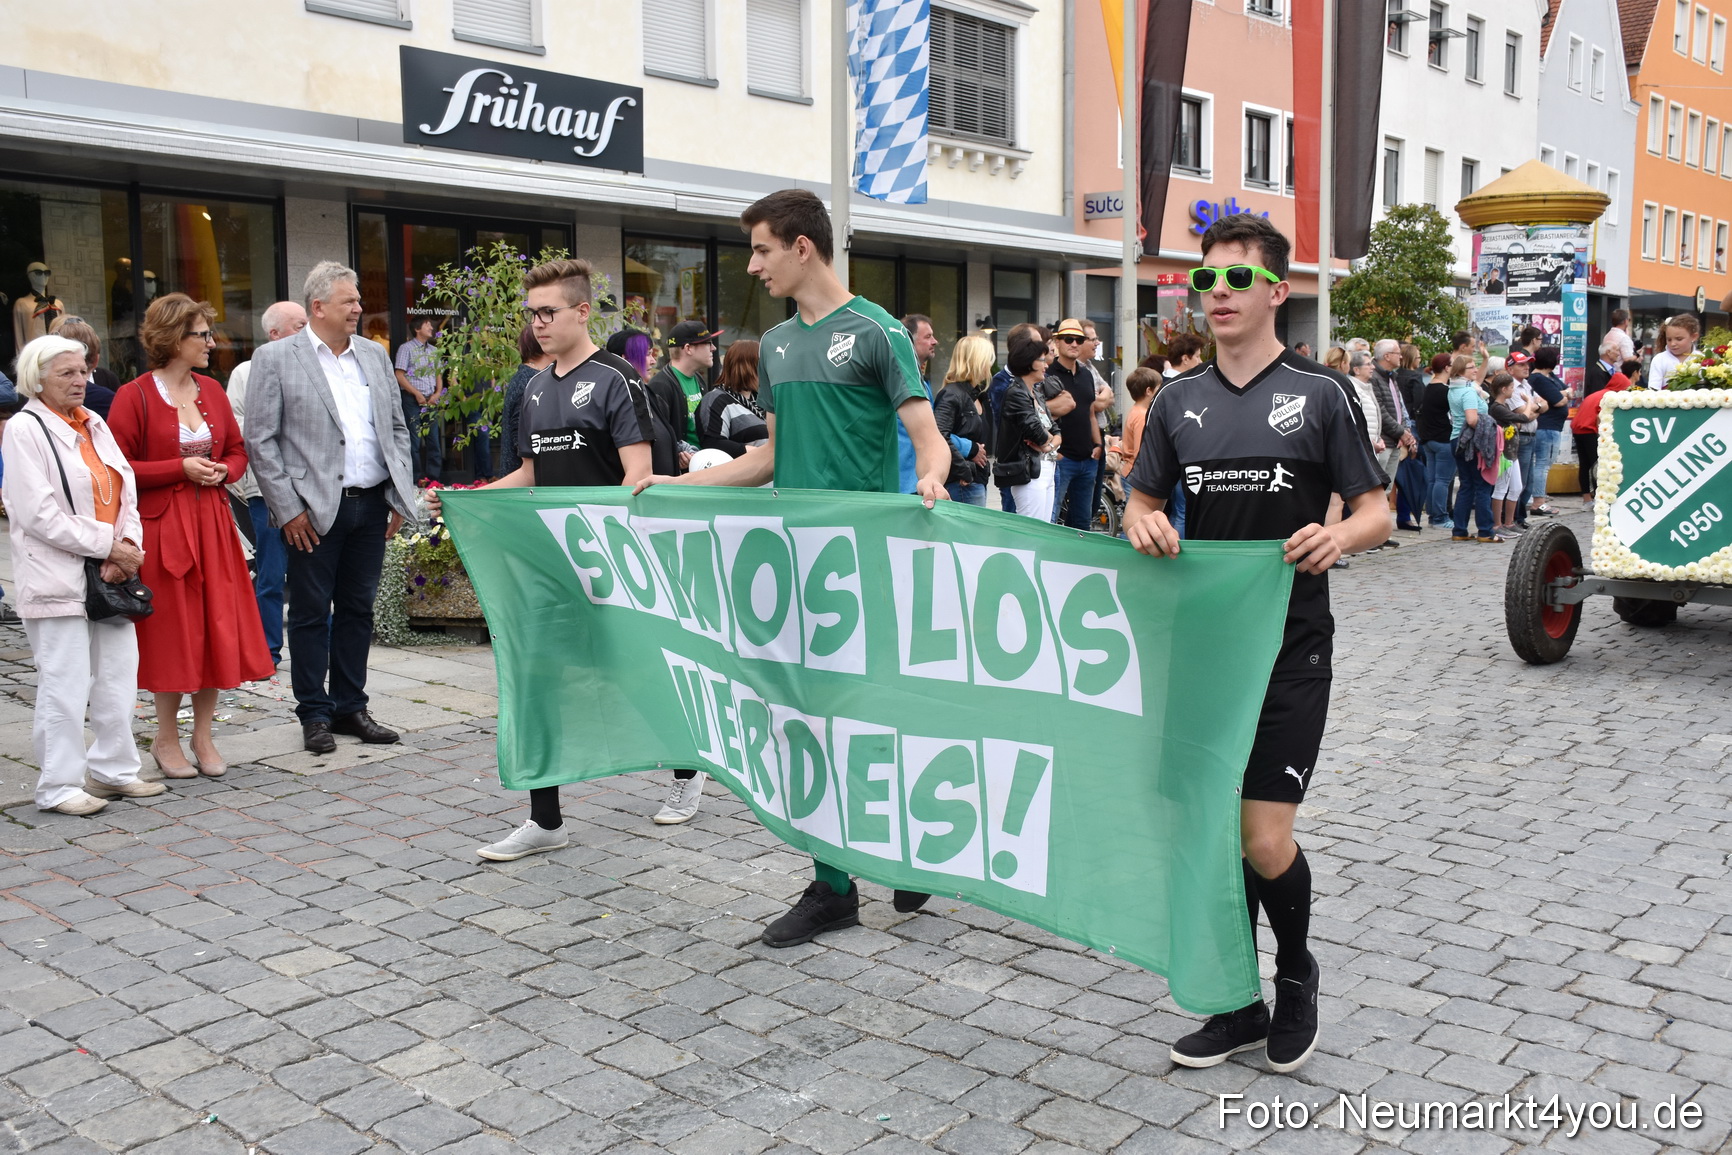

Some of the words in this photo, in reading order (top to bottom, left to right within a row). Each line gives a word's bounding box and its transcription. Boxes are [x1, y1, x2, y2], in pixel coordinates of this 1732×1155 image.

[419, 68, 637, 157] frühauf
[406, 307, 433, 315] Modern
[434, 307, 460, 316] Women
[833, 334, 845, 342] SV
[834, 351, 848, 362] 1950
[1275, 395, 1290, 404] SV
[1280, 416, 1299, 430] 1950
[1629, 416, 1677, 444] SV
[1203, 470, 1270, 481] sarango
[1625, 432, 1727, 523] PÖLLING
[1206, 484, 1265, 492] TEAMSPORT
[1669, 502, 1723, 548] 1950
[562, 512, 862, 657] SOMOS
[908, 548, 1131, 696] LOS
[673, 664, 1050, 880] VERDES!
